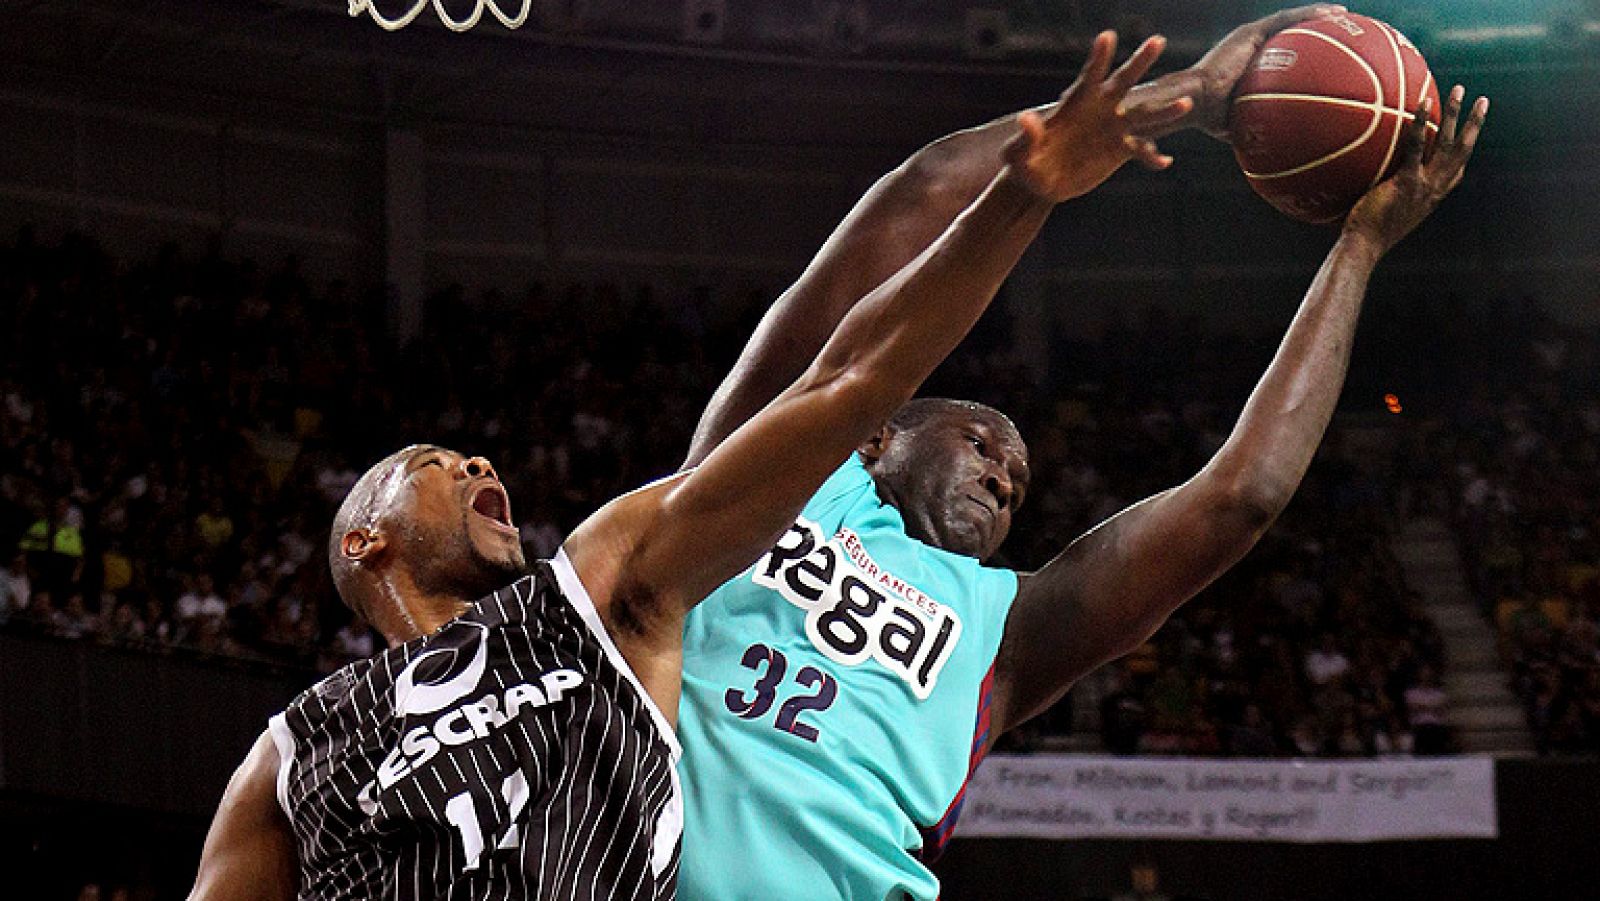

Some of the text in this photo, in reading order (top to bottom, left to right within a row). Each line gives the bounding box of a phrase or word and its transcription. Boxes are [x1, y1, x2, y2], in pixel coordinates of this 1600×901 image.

[762, 523, 954, 689] Regal
[834, 528, 938, 616] SEGURANCES
[725, 643, 838, 743] 32
